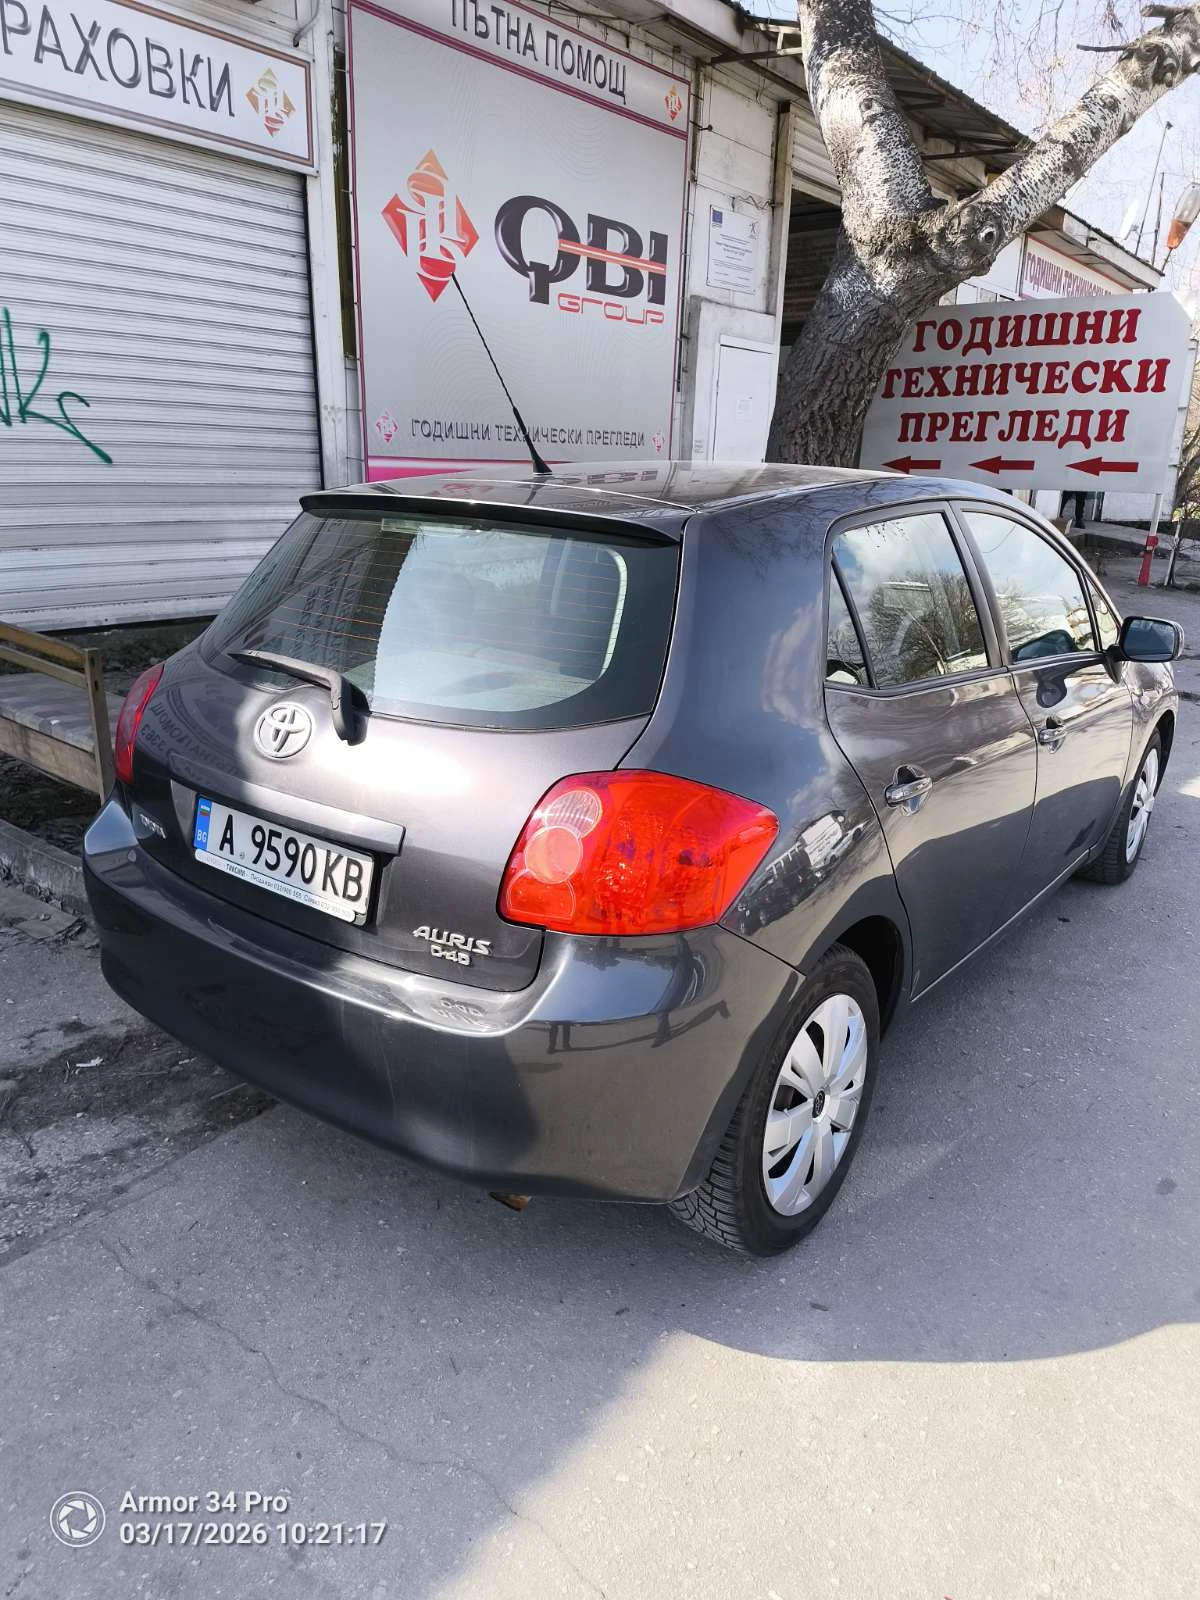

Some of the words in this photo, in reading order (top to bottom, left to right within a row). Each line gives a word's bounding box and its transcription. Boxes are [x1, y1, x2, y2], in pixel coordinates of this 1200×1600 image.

[545, 30, 627, 105] ПОМОЩ
[494, 194, 669, 306] QBI
[912, 308, 1142, 356] ГОДИШНИ
[881, 358, 1171, 399] ТЕХНИЧЕСКИ
[411, 418, 491, 443] ГОДИШНИ
[586, 429, 645, 449] ПРЕГЛЕДИ
[897, 409, 1130, 450] ПРЕГЛЕДИ
[196, 829, 208, 842] BG
[219, 814, 235, 856] A
[412, 925, 492, 956] AURIS
[430, 943, 471, 966] D-4D
